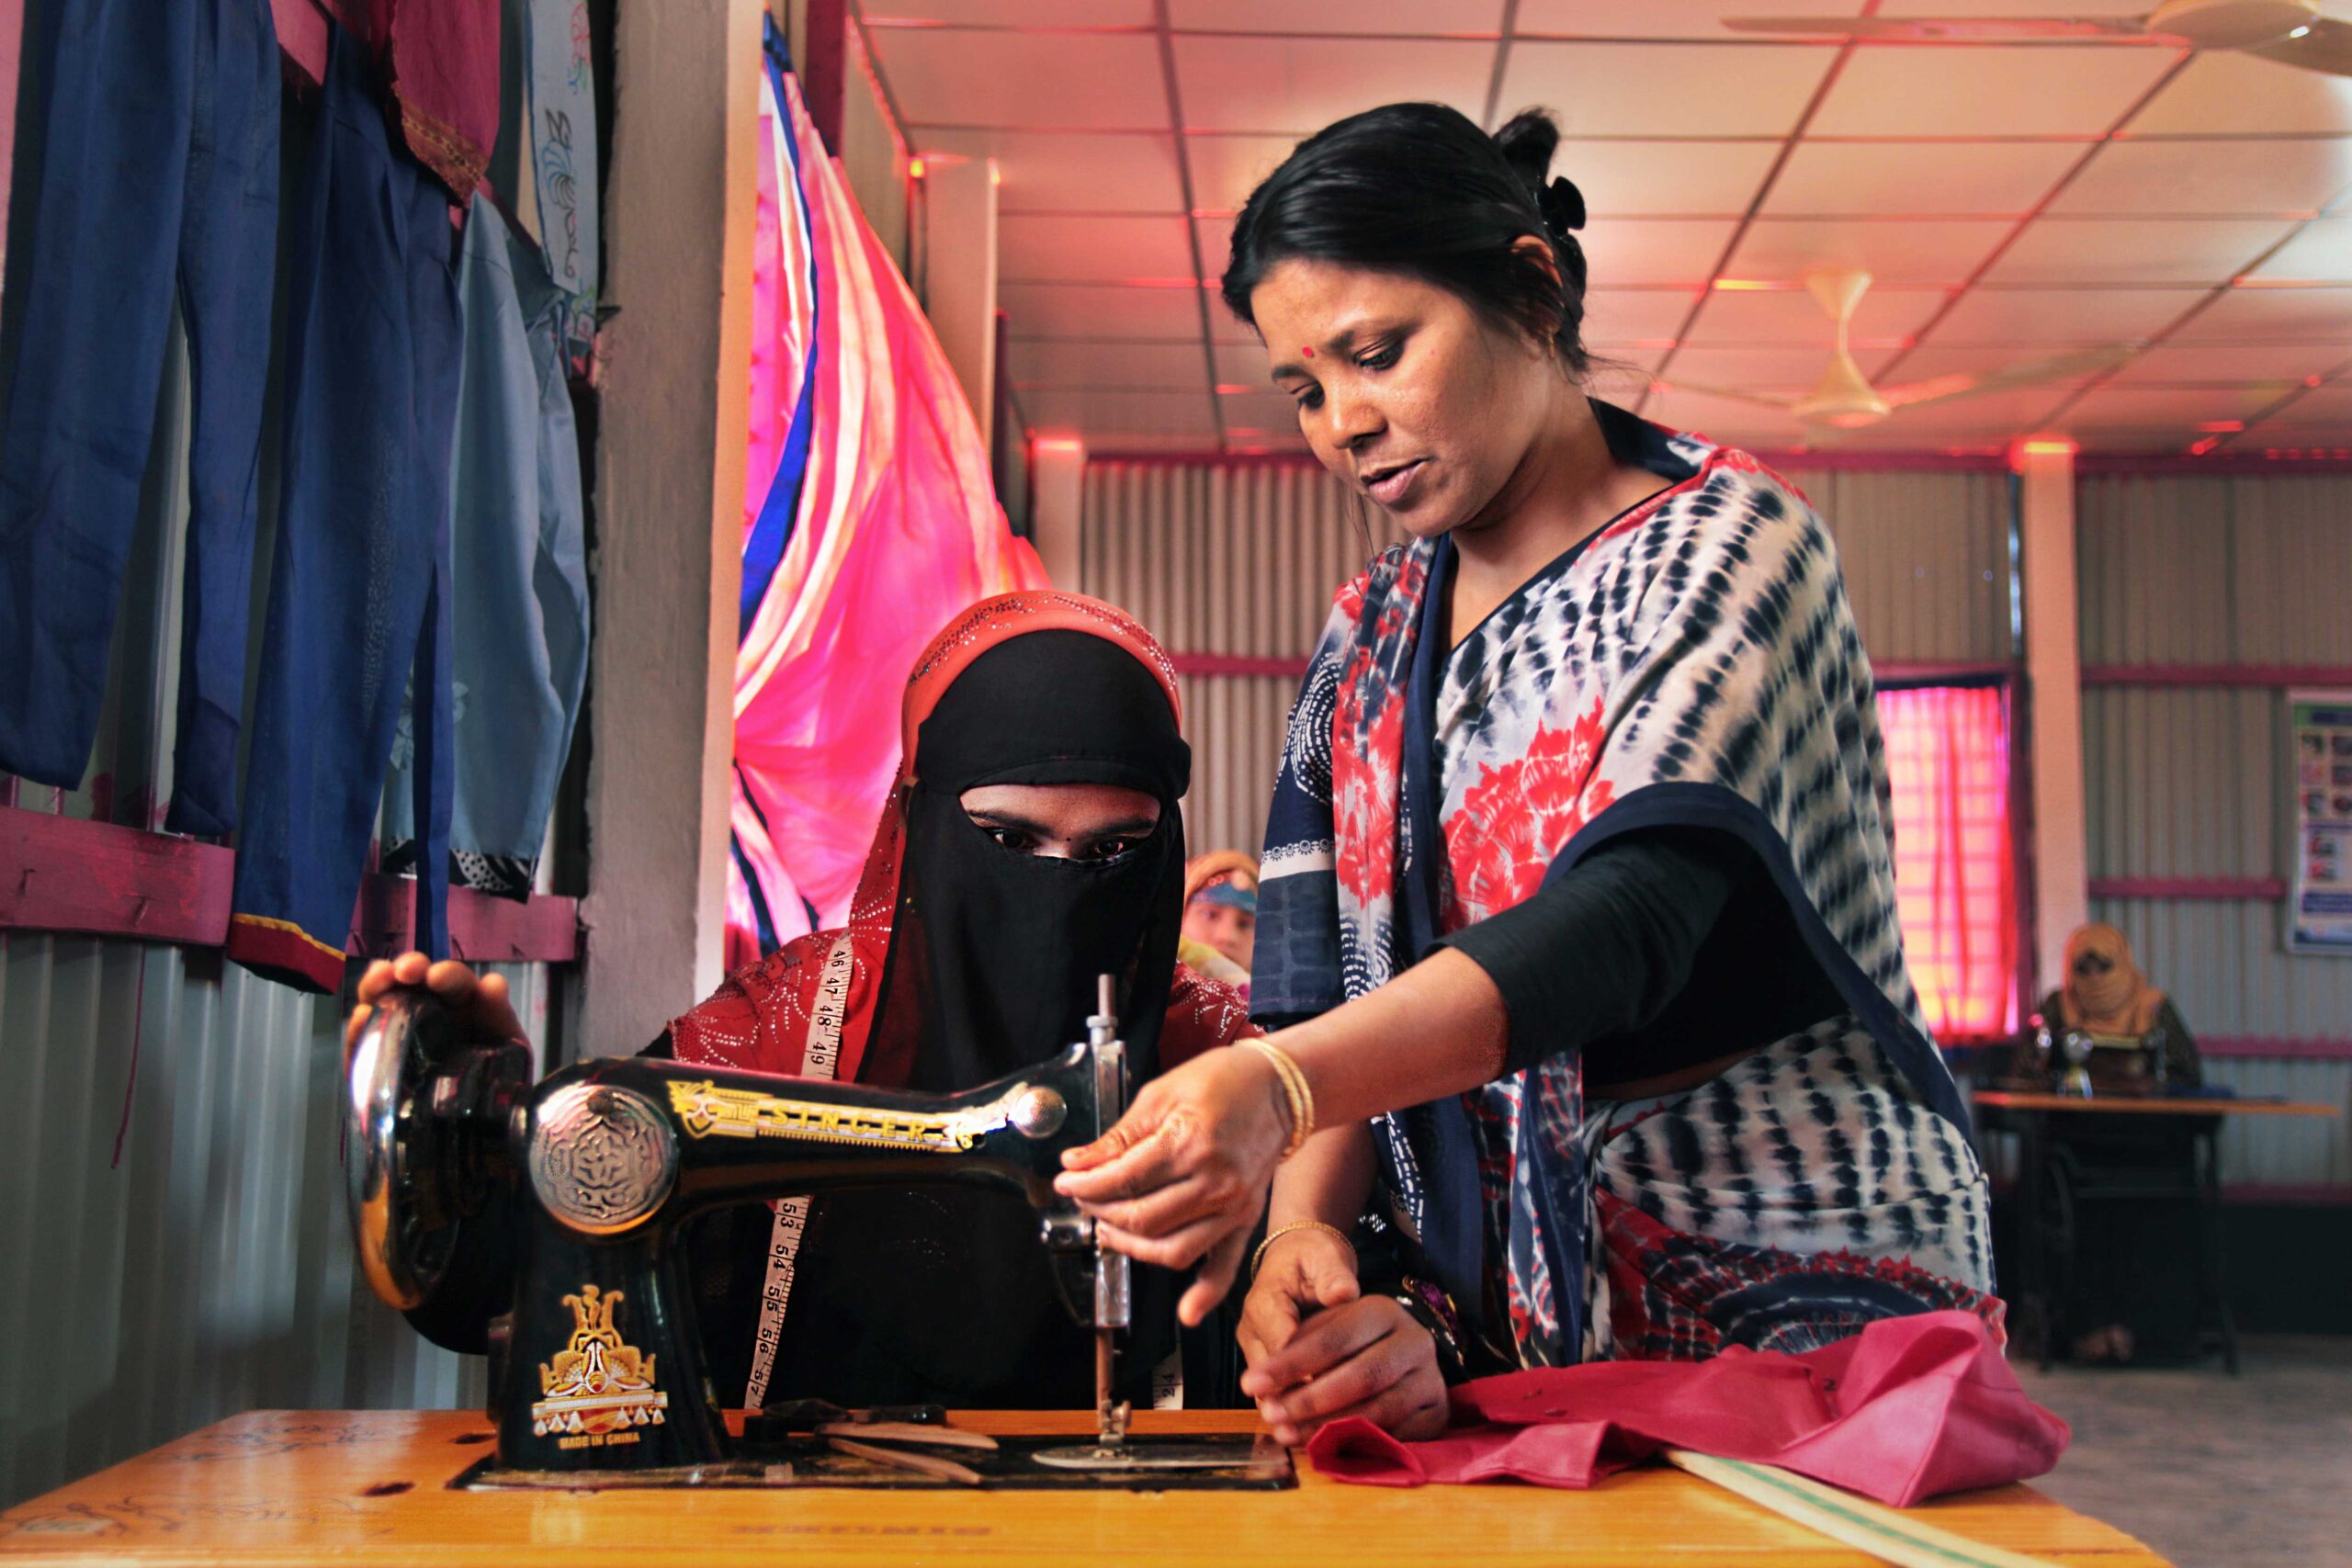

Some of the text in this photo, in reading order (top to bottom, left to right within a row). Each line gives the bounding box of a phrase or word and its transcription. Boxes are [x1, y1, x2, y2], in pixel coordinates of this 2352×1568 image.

[831, 951, 846, 968] 46
[824, 977, 840, 995] 47
[817, 1005, 833, 1026] 48
[810, 1042, 827, 1065] 49
[771, 1105, 926, 1143] SINGER
[780, 1202, 797, 1228] 53
[774, 1244, 789, 1269] 54
[766, 1286, 781, 1312] 55
[759, 1327, 772, 1354] 56
[751, 1370, 763, 1396] 57
[559, 1431, 640, 1450] MADE IN CHINA
